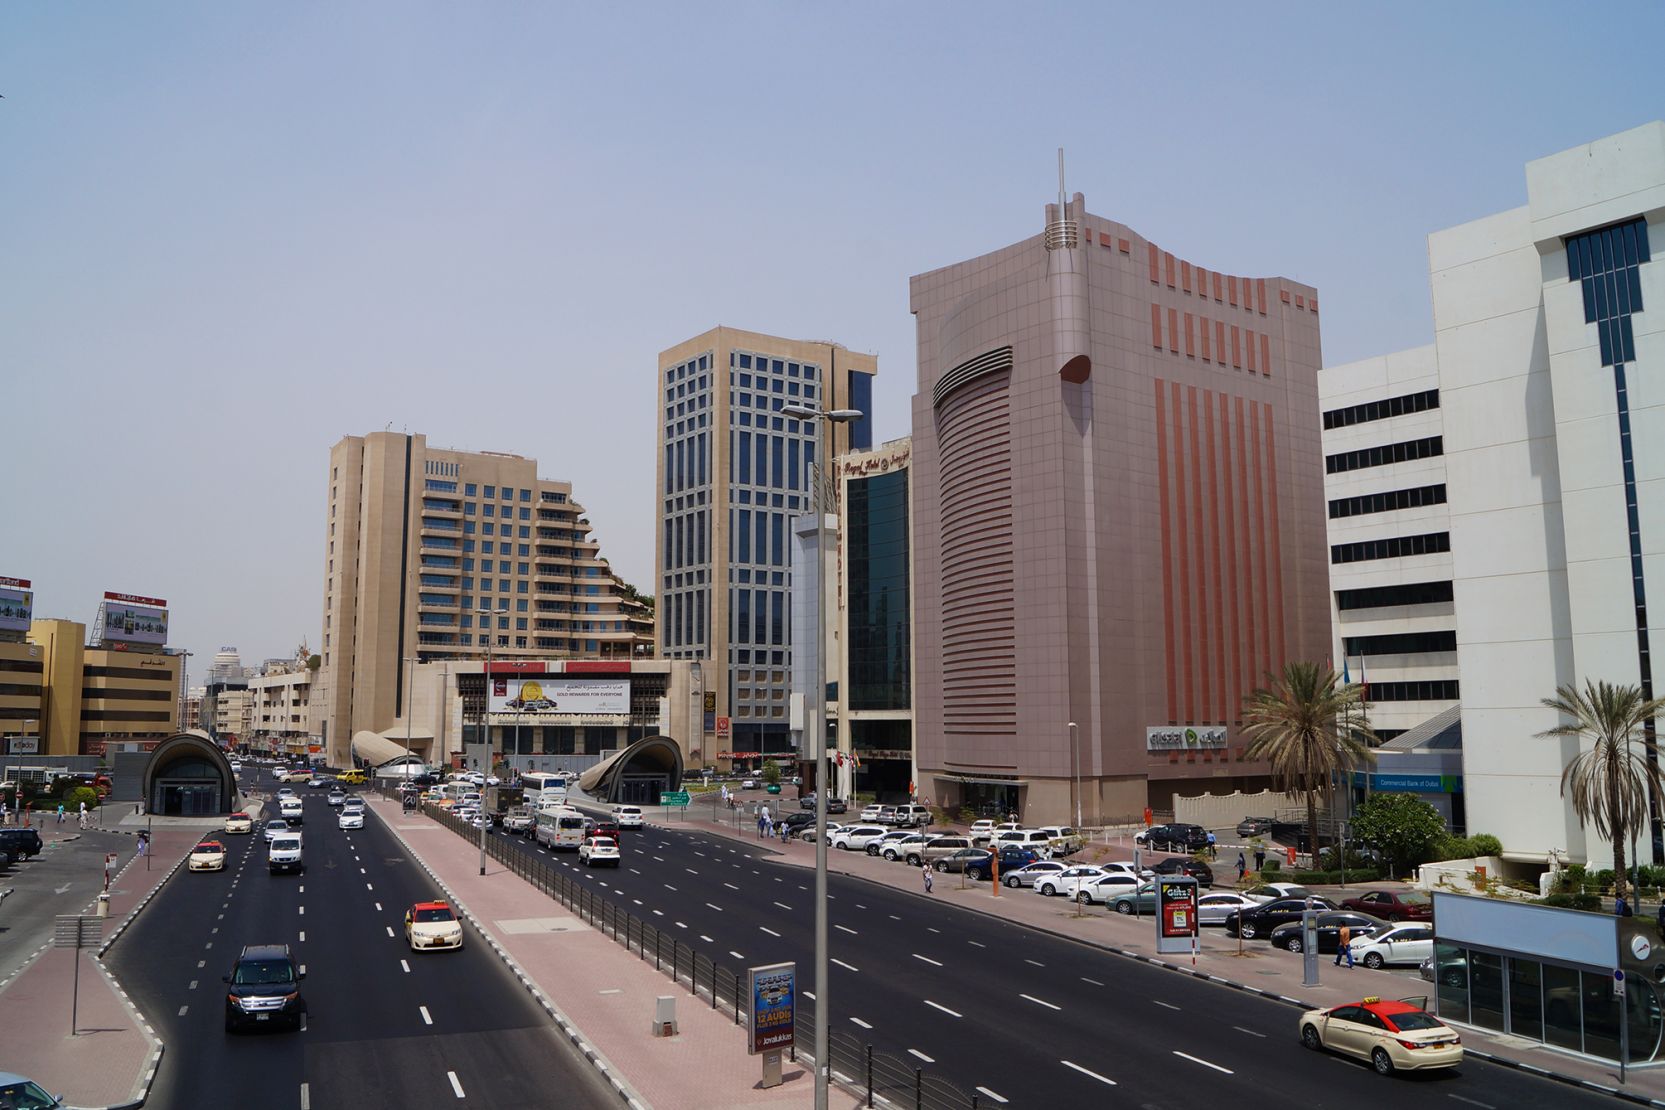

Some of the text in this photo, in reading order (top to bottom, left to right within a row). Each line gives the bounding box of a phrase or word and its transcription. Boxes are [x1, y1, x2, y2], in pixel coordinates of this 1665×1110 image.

[1425, 780, 1439, 788] Dubai
[757, 1014, 766, 1023] 12
[763, 1033, 792, 1045] Joyalukkas
